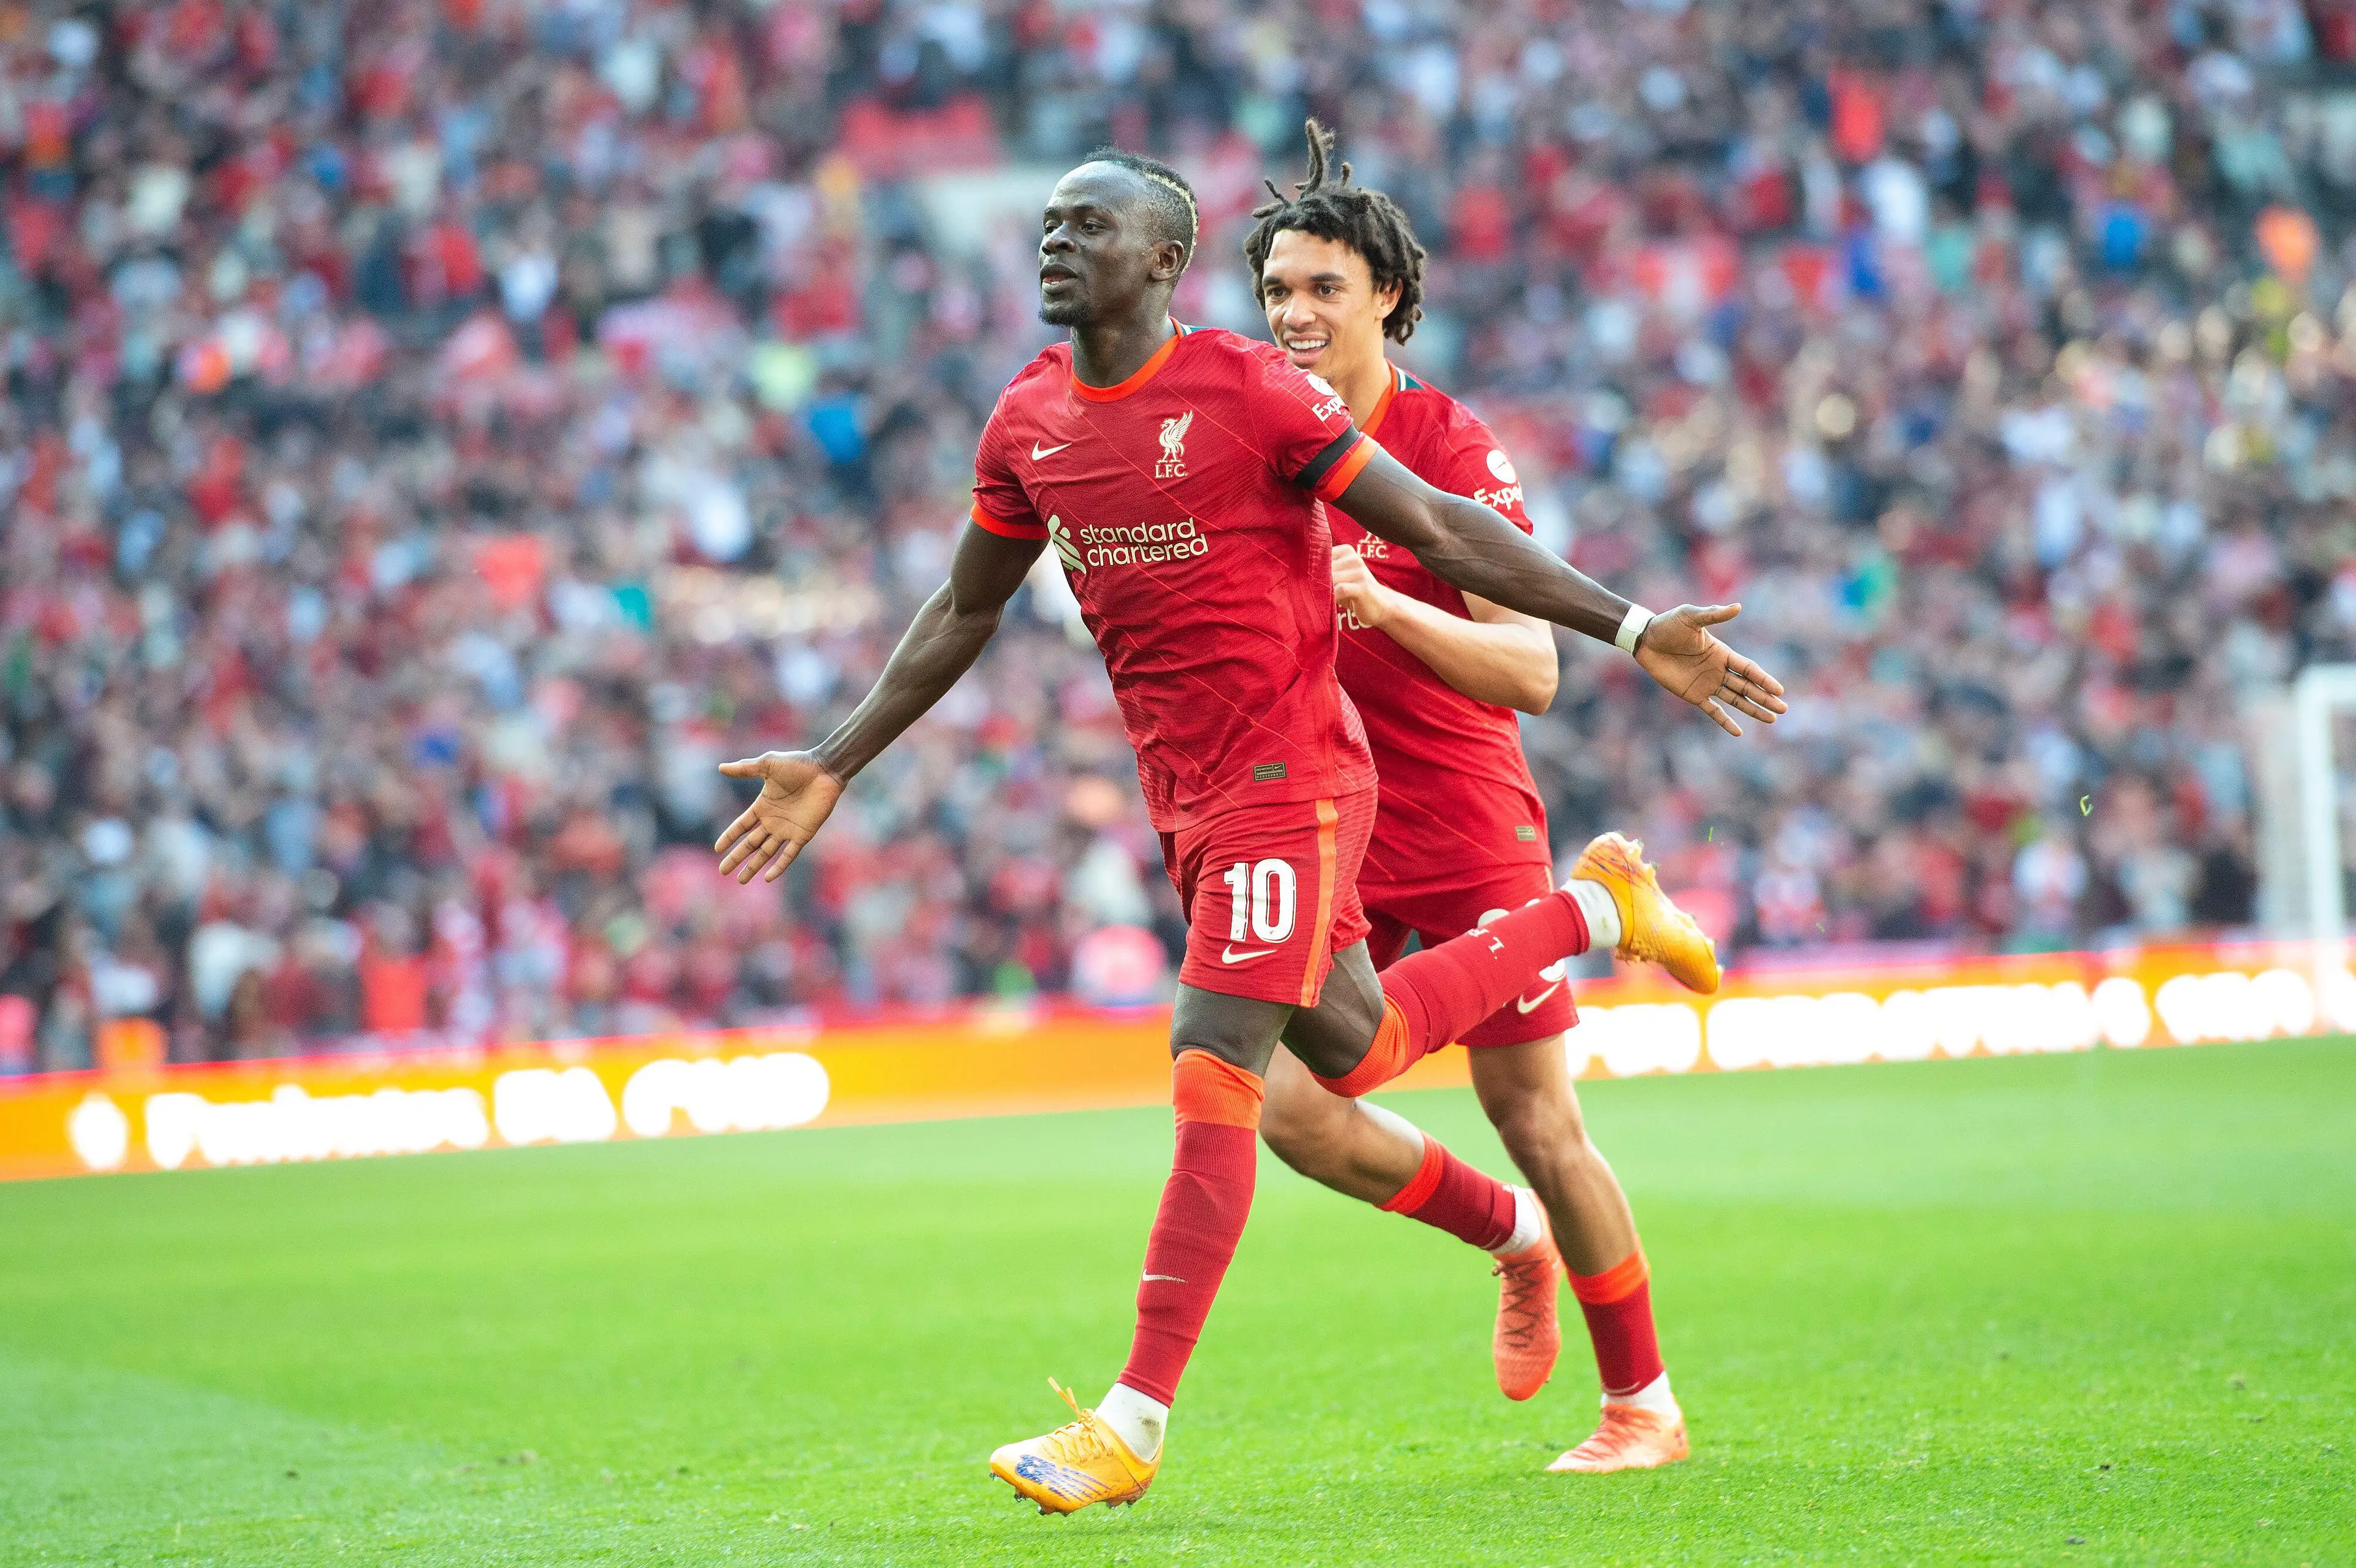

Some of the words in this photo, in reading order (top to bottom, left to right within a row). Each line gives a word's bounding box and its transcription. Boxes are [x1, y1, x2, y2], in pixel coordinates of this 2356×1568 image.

[1080, 517, 1196, 545] standard
[1087, 534, 1209, 566] chartered
[1223, 858, 1297, 943] 10
